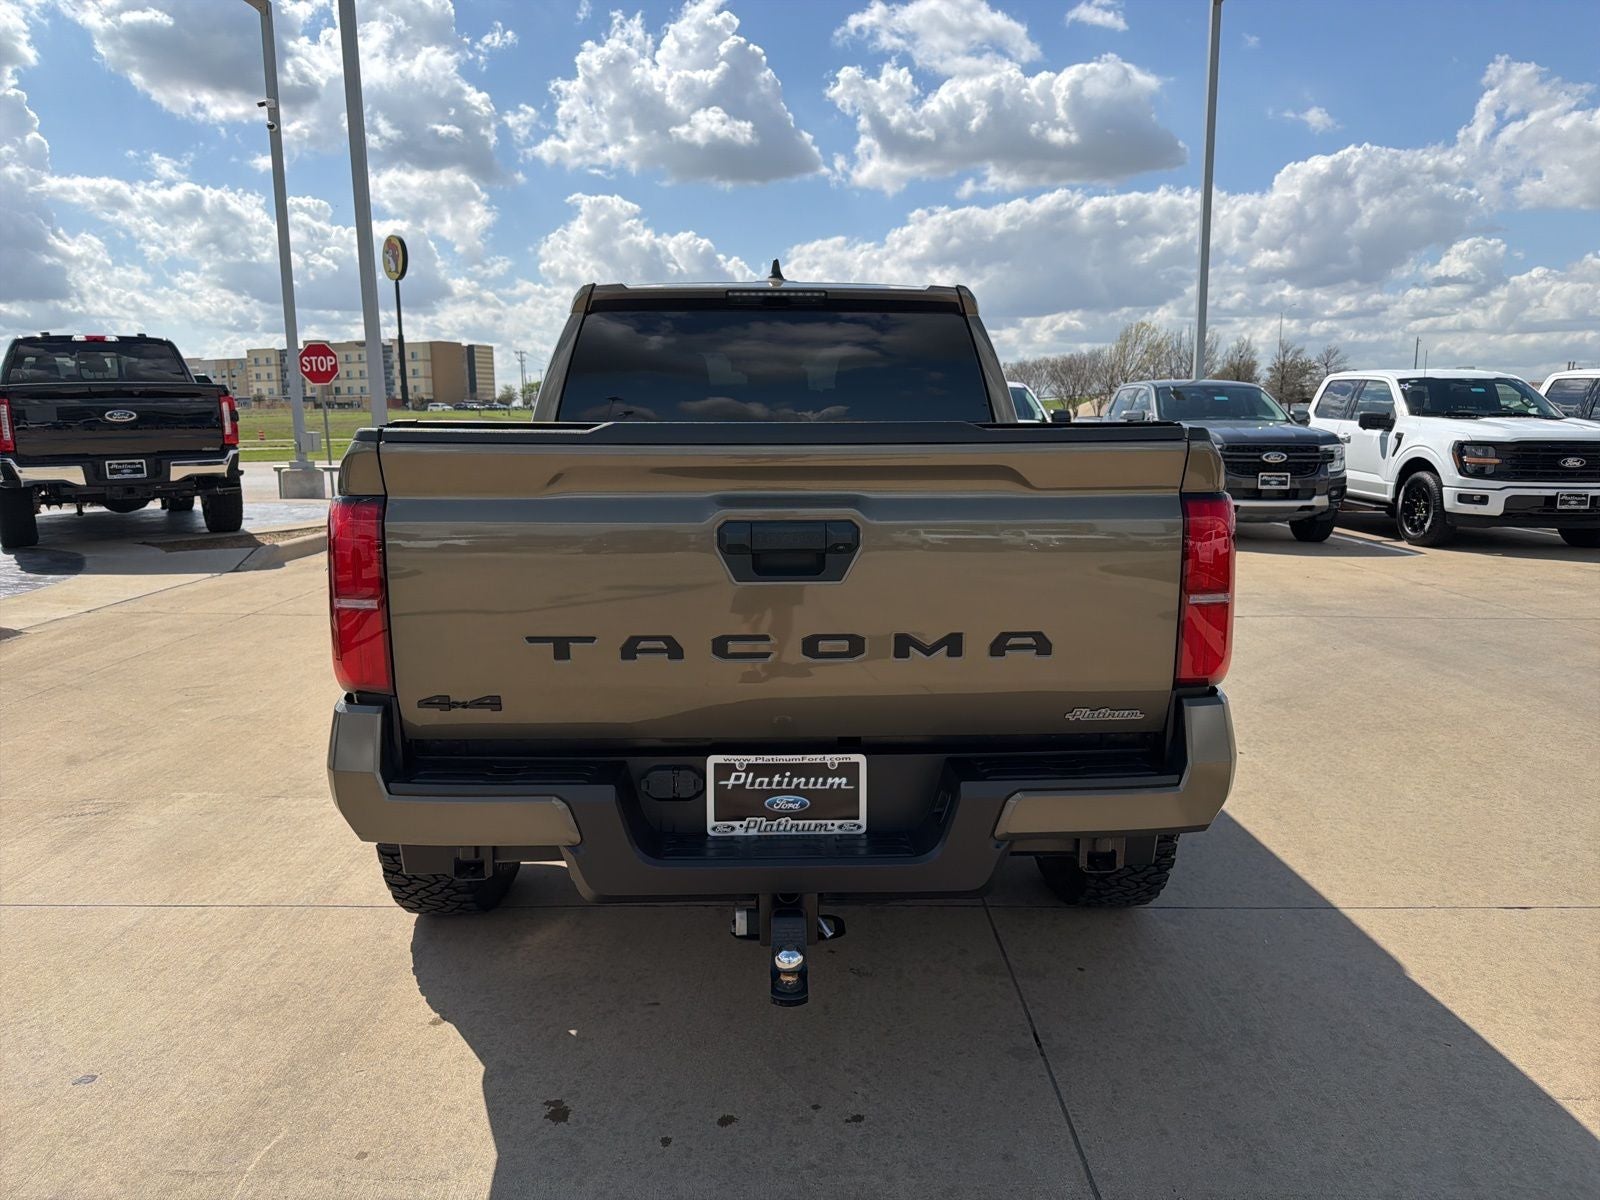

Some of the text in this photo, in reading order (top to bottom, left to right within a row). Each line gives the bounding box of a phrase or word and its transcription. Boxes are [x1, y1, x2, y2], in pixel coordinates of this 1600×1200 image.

[301, 356, 336, 372] STOP
[523, 631, 1053, 664] TACOMA
[417, 694, 503, 712] 4x4
[1064, 707, 1145, 721] Platinum
[718, 772, 855, 790] Platinum
[773, 798, 801, 810] Ford
[743, 818, 835, 834] Platinum
